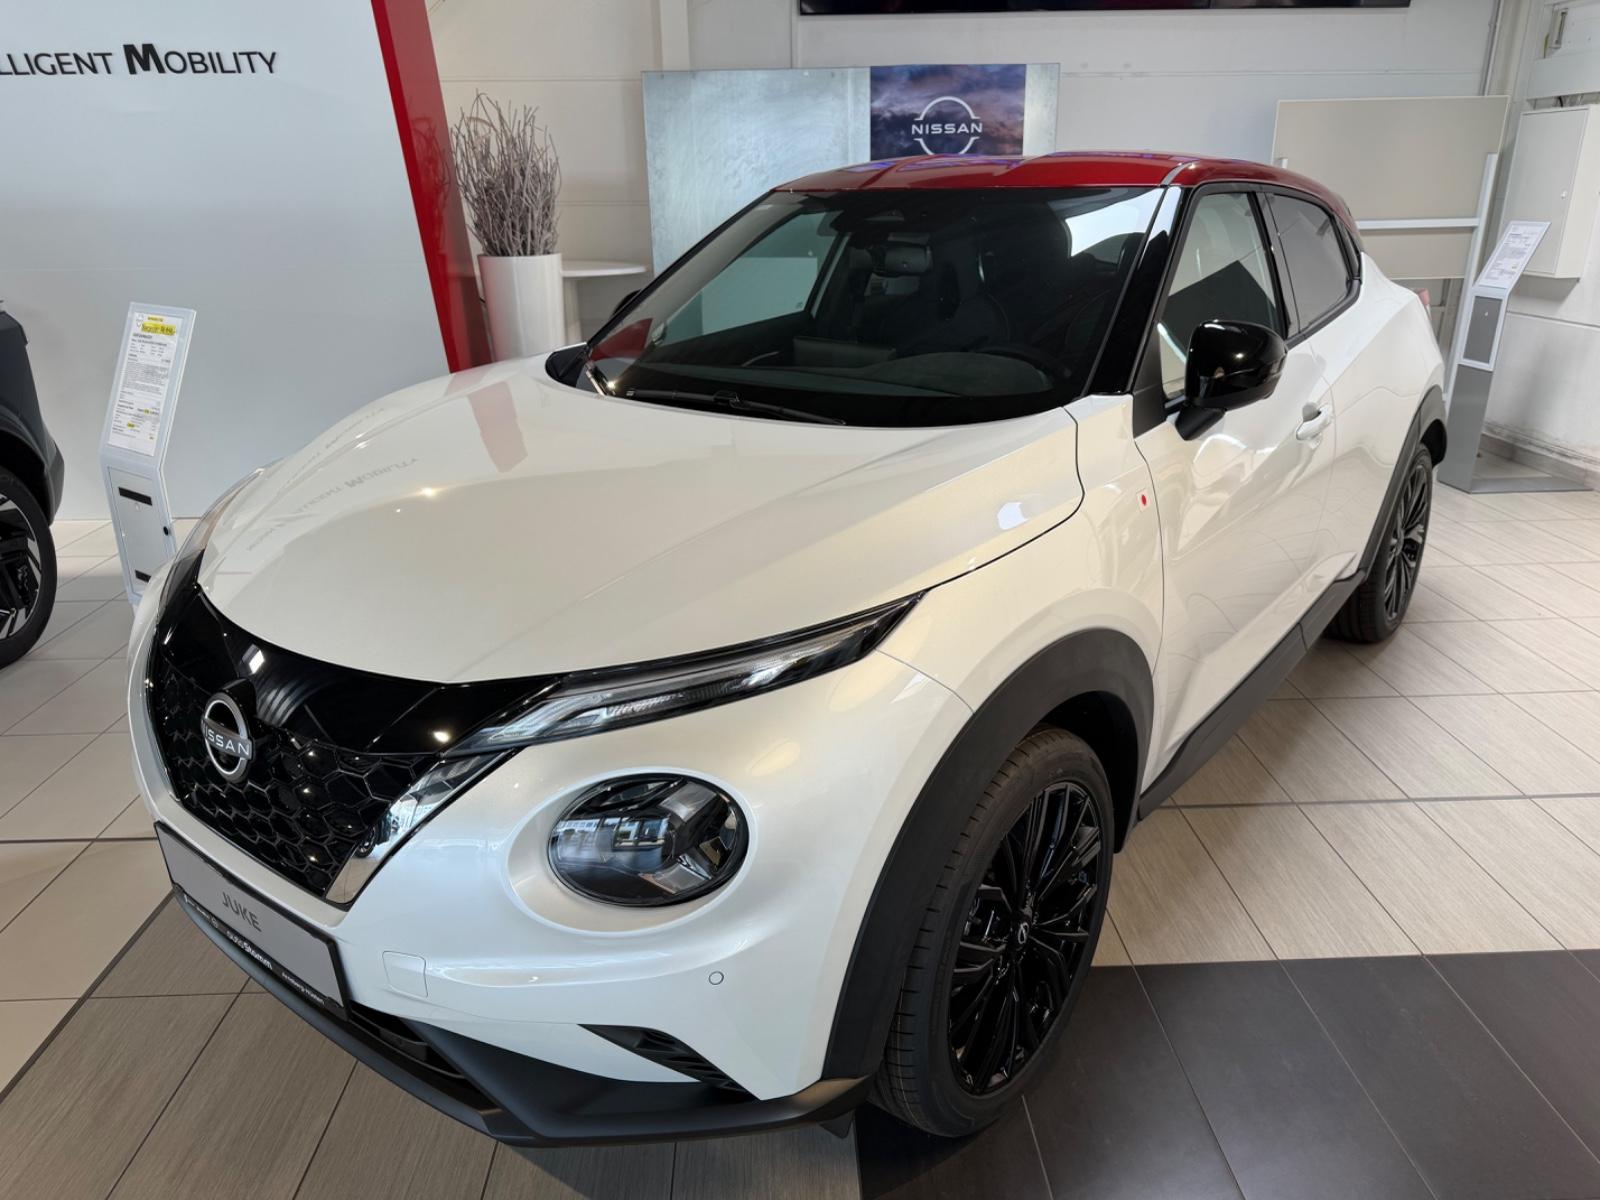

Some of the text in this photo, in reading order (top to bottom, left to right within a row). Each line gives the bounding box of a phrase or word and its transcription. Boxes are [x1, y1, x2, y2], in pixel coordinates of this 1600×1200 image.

[122, 43, 276, 75] MOBILITY
[911, 122, 983, 135] NISSAN
[222, 891, 263, 933] JUKE
